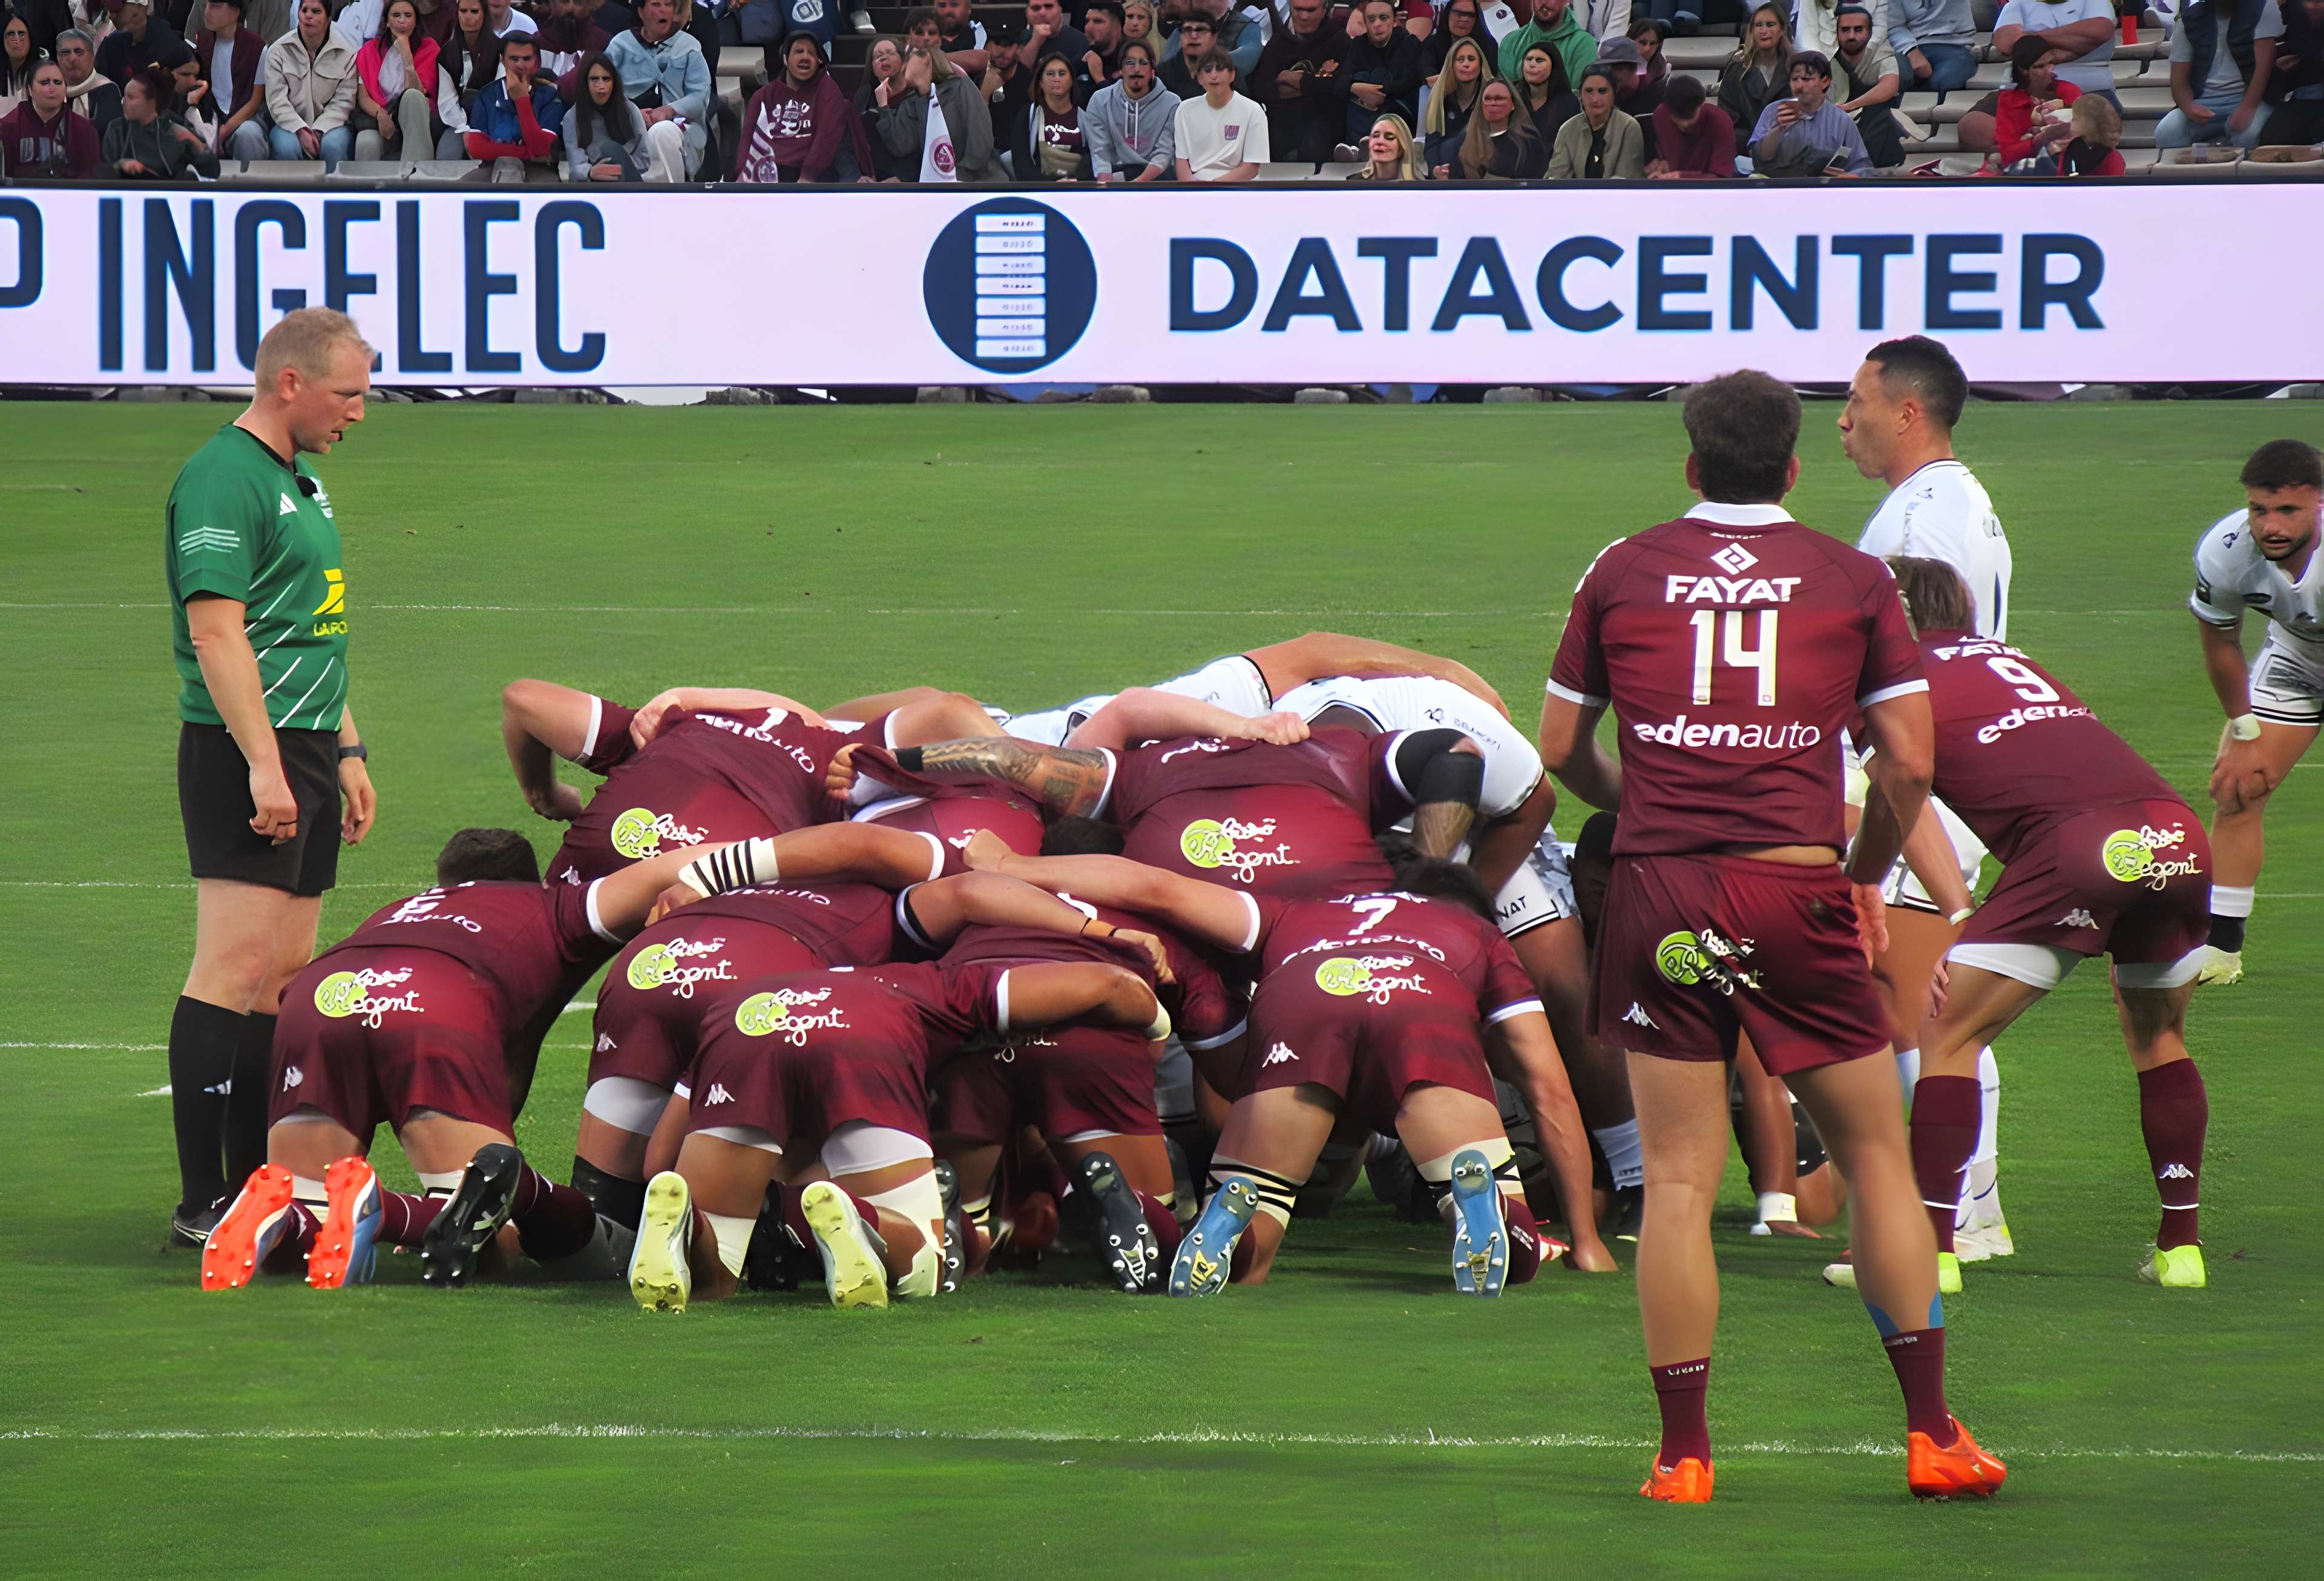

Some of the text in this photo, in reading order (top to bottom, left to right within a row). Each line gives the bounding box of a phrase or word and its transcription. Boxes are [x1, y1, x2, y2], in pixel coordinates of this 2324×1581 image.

[99, 198, 606, 373] INGELEC
[1169, 233, 2106, 334] DATACENTER
[1666, 574, 1802, 604] FAYAT
[1689, 609, 1778, 706] 14
[1986, 656, 2061, 703] 9
[1633, 714, 1821, 749] edenauto
[1348, 898, 1397, 936] 7
